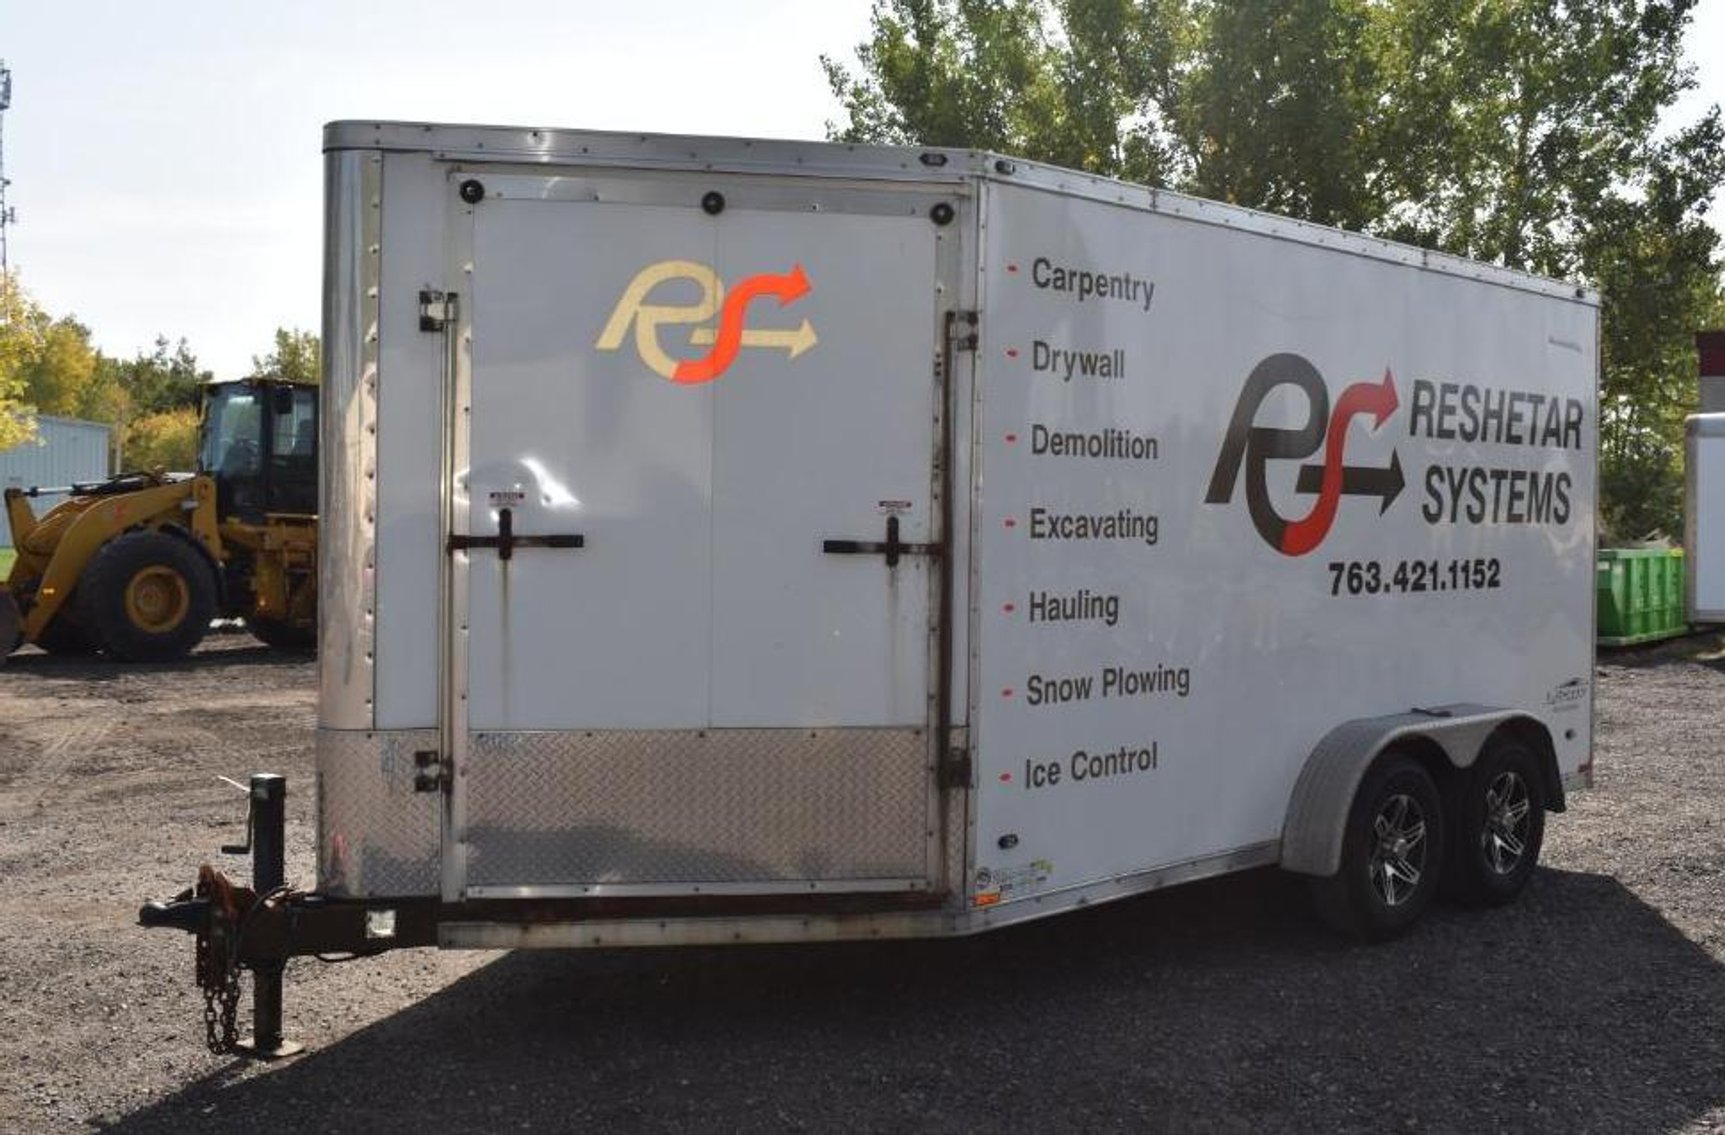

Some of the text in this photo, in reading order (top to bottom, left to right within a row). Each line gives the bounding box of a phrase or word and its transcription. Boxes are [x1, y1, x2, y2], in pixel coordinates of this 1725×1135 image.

[1031, 257, 1156, 312] Carpentry
[1032, 340, 1125, 382] Drywall
[1409, 379, 1584, 450] RESHETAR
[1031, 424, 1159, 460] Demolition
[1421, 465, 1573, 525] SYSTEMS
[1029, 507, 1159, 546] Excavating
[1329, 558, 1501, 596] 763.421.1152
[1029, 589, 1120, 627] Hauling
[1026, 663, 1191, 706] Snow Plowing
[1024, 741, 1159, 790] Ice Control
